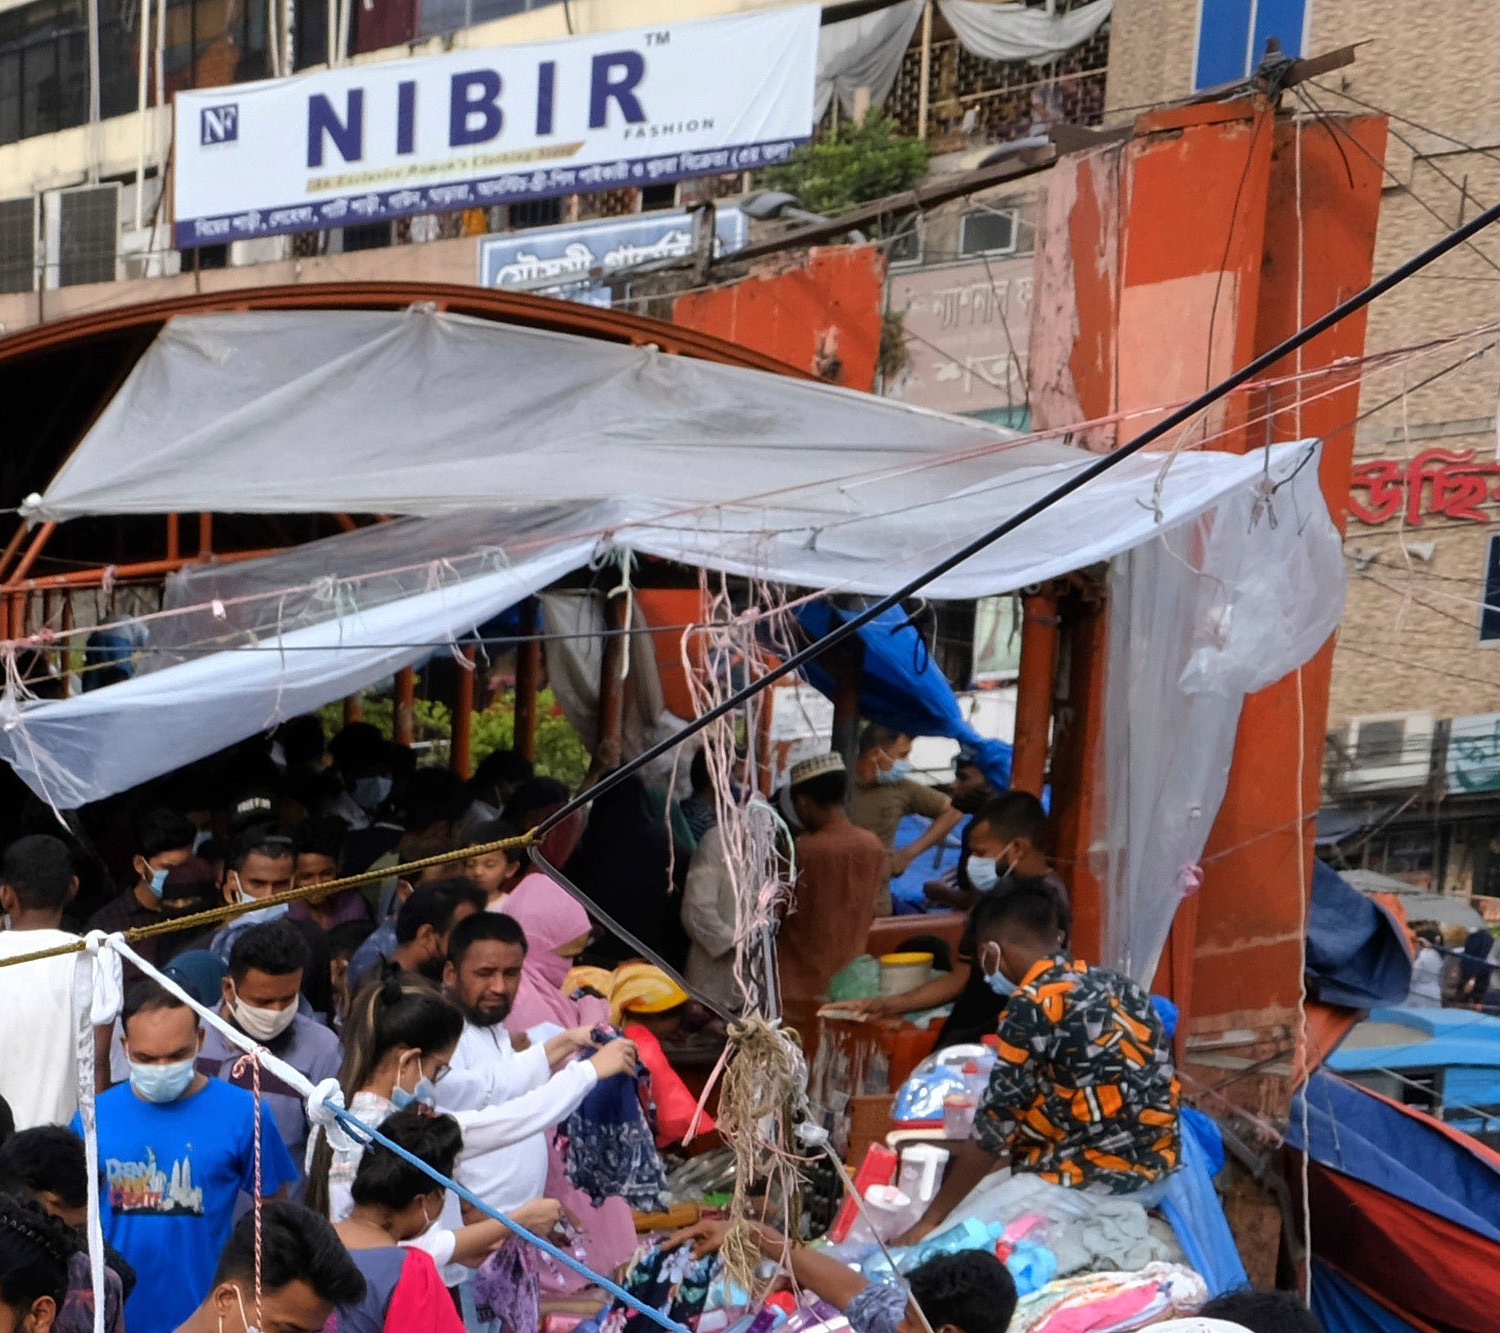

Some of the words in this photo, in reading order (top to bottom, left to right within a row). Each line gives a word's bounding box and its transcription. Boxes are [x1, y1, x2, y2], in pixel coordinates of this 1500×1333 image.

[306, 50, 649, 168] NIBIR
[624, 118, 716, 141] FASHION
[336, 167, 402, 188] Exclusive
